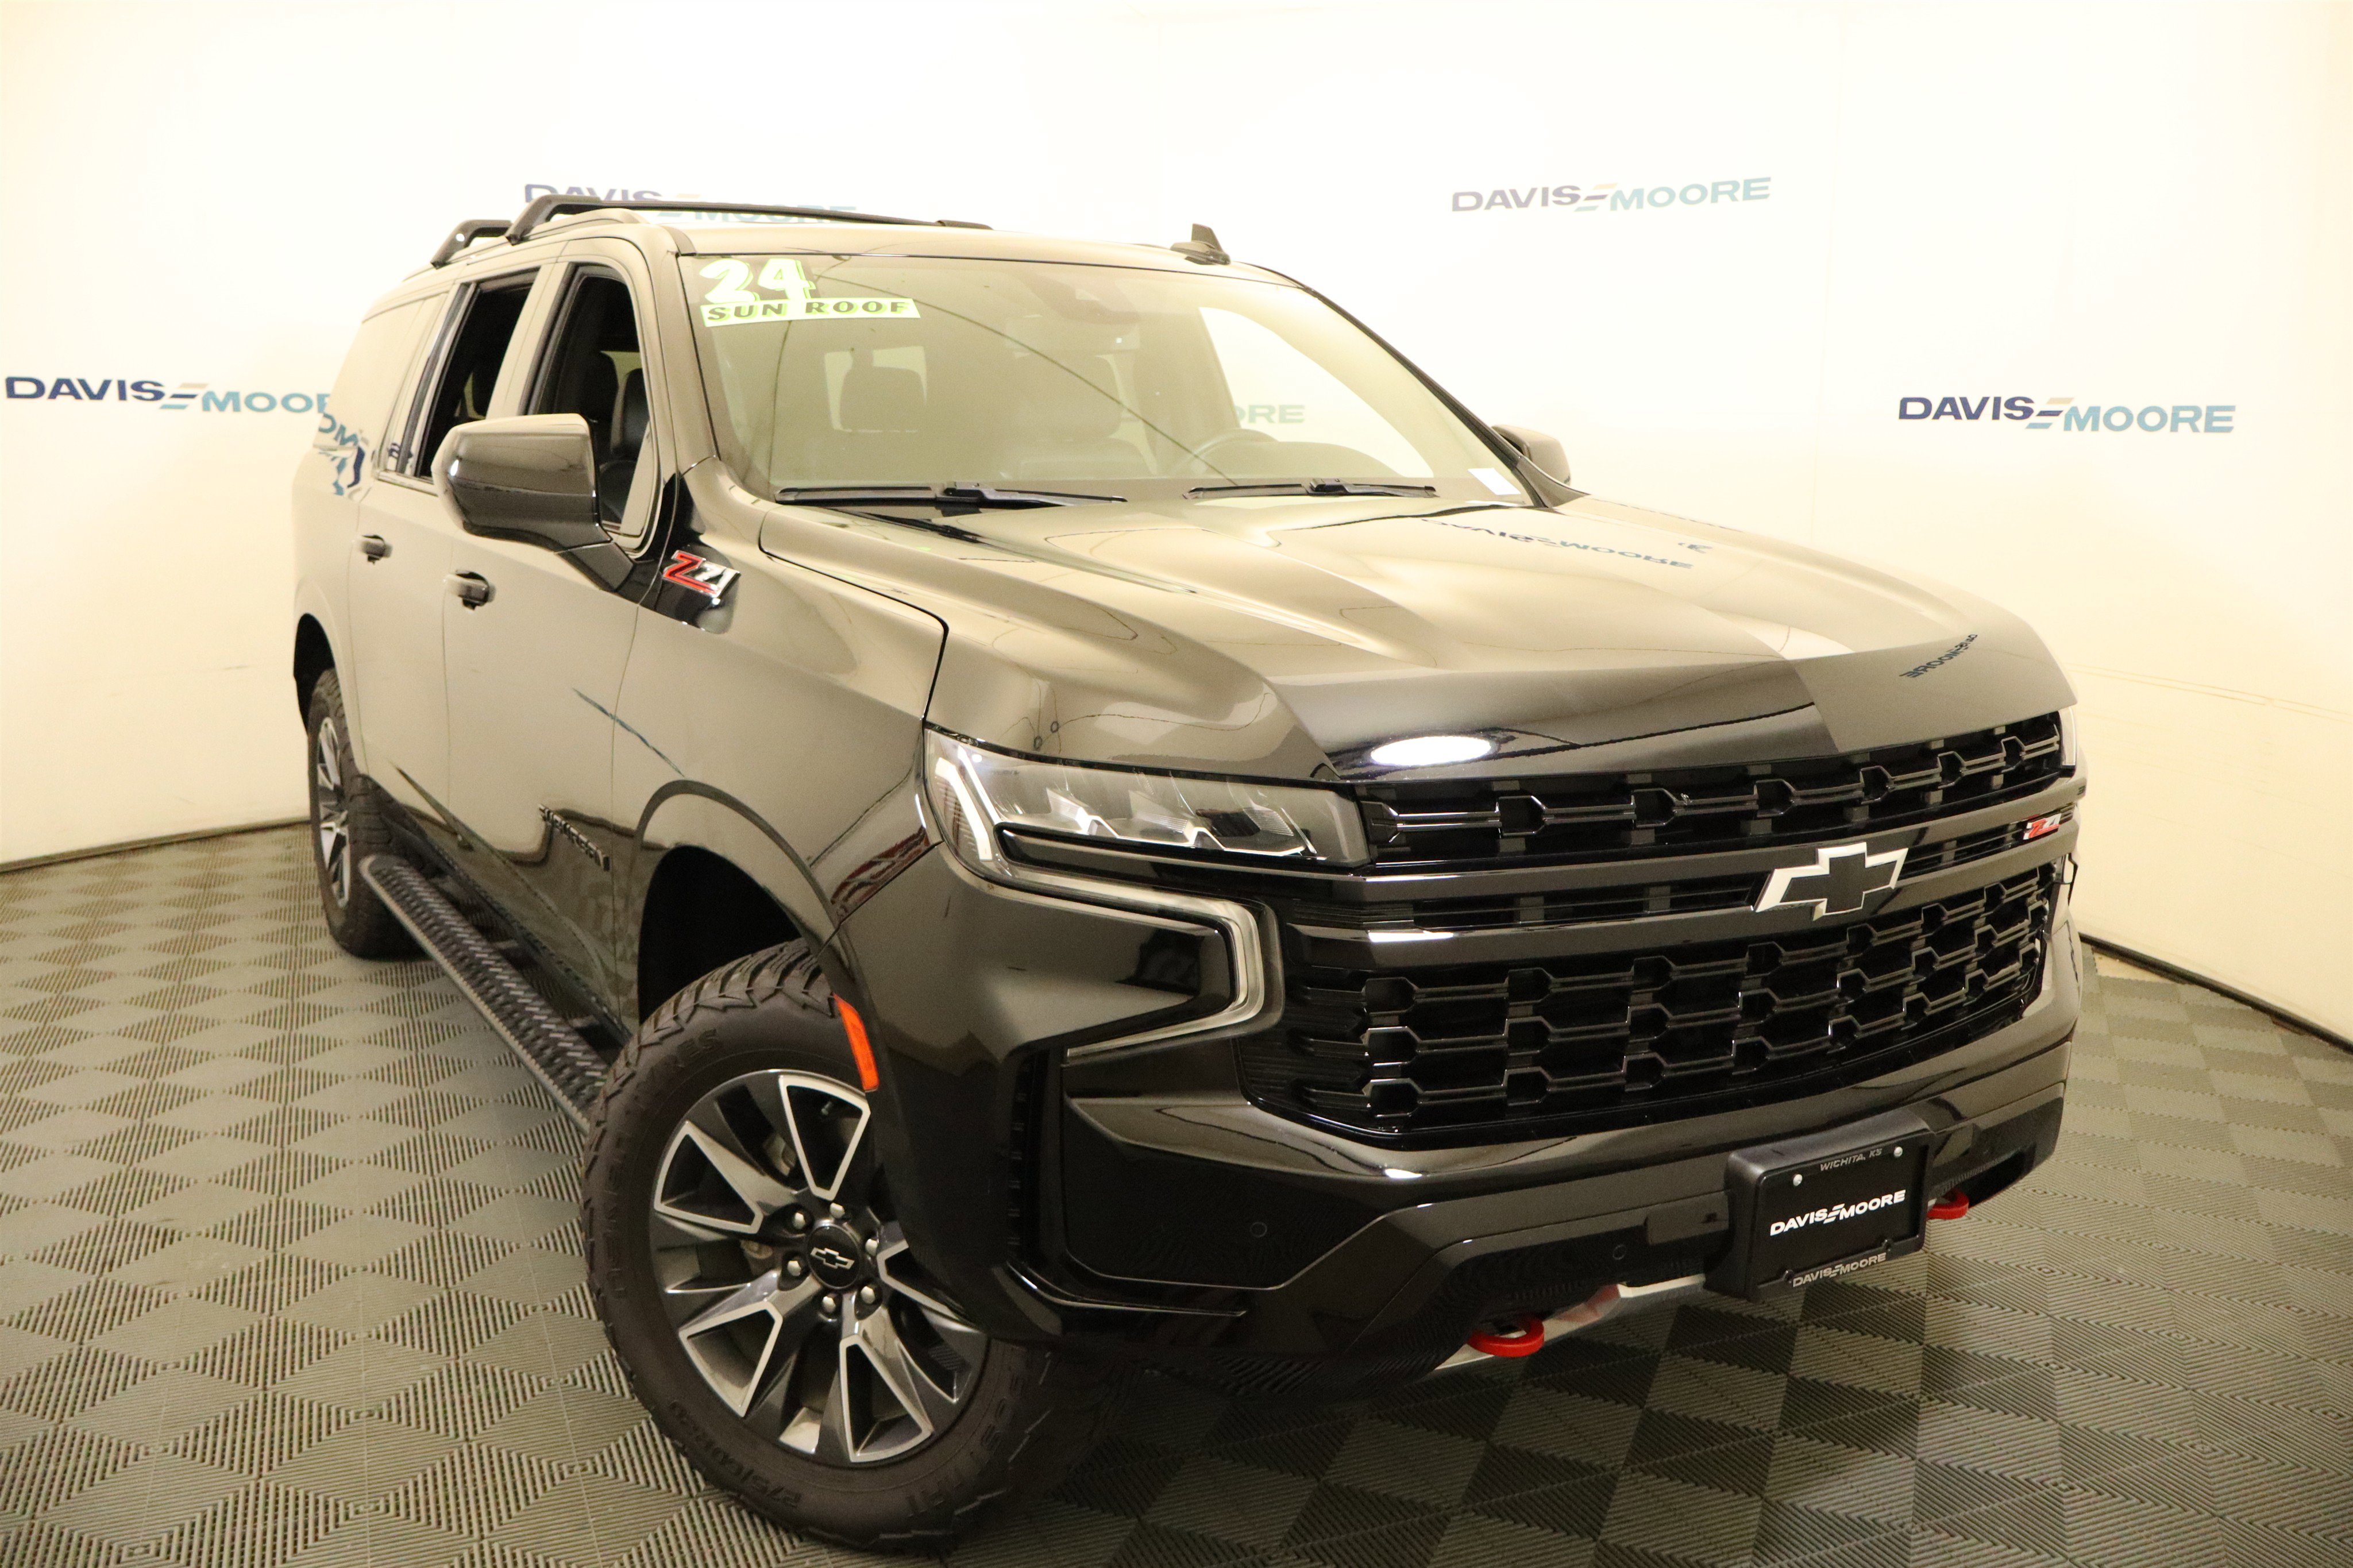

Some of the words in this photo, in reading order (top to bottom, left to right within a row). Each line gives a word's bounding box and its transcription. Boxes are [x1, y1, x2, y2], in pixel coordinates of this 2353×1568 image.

[1452, 185, 1581, 212] DAVIS
[1610, 177, 1771, 211] MOORE
[699, 258, 817, 304] 24
[707, 303, 788, 320] SUN
[805, 300, 911, 314] ROOF
[5, 376, 164, 401] DAVIS
[1898, 396, 2035, 421] DAVIS
[2063, 405, 2235, 433] MOORE
[1819, 1153, 1866, 1171] WICHITA,
[1869, 1148, 1883, 1158] KS
[1770, 1208, 1828, 1236] DAVIS
[1839, 1189, 1906, 1220] MOORE
[1792, 1267, 1833, 1288] DAVIS
[1839, 1252, 1887, 1275] MOORE
